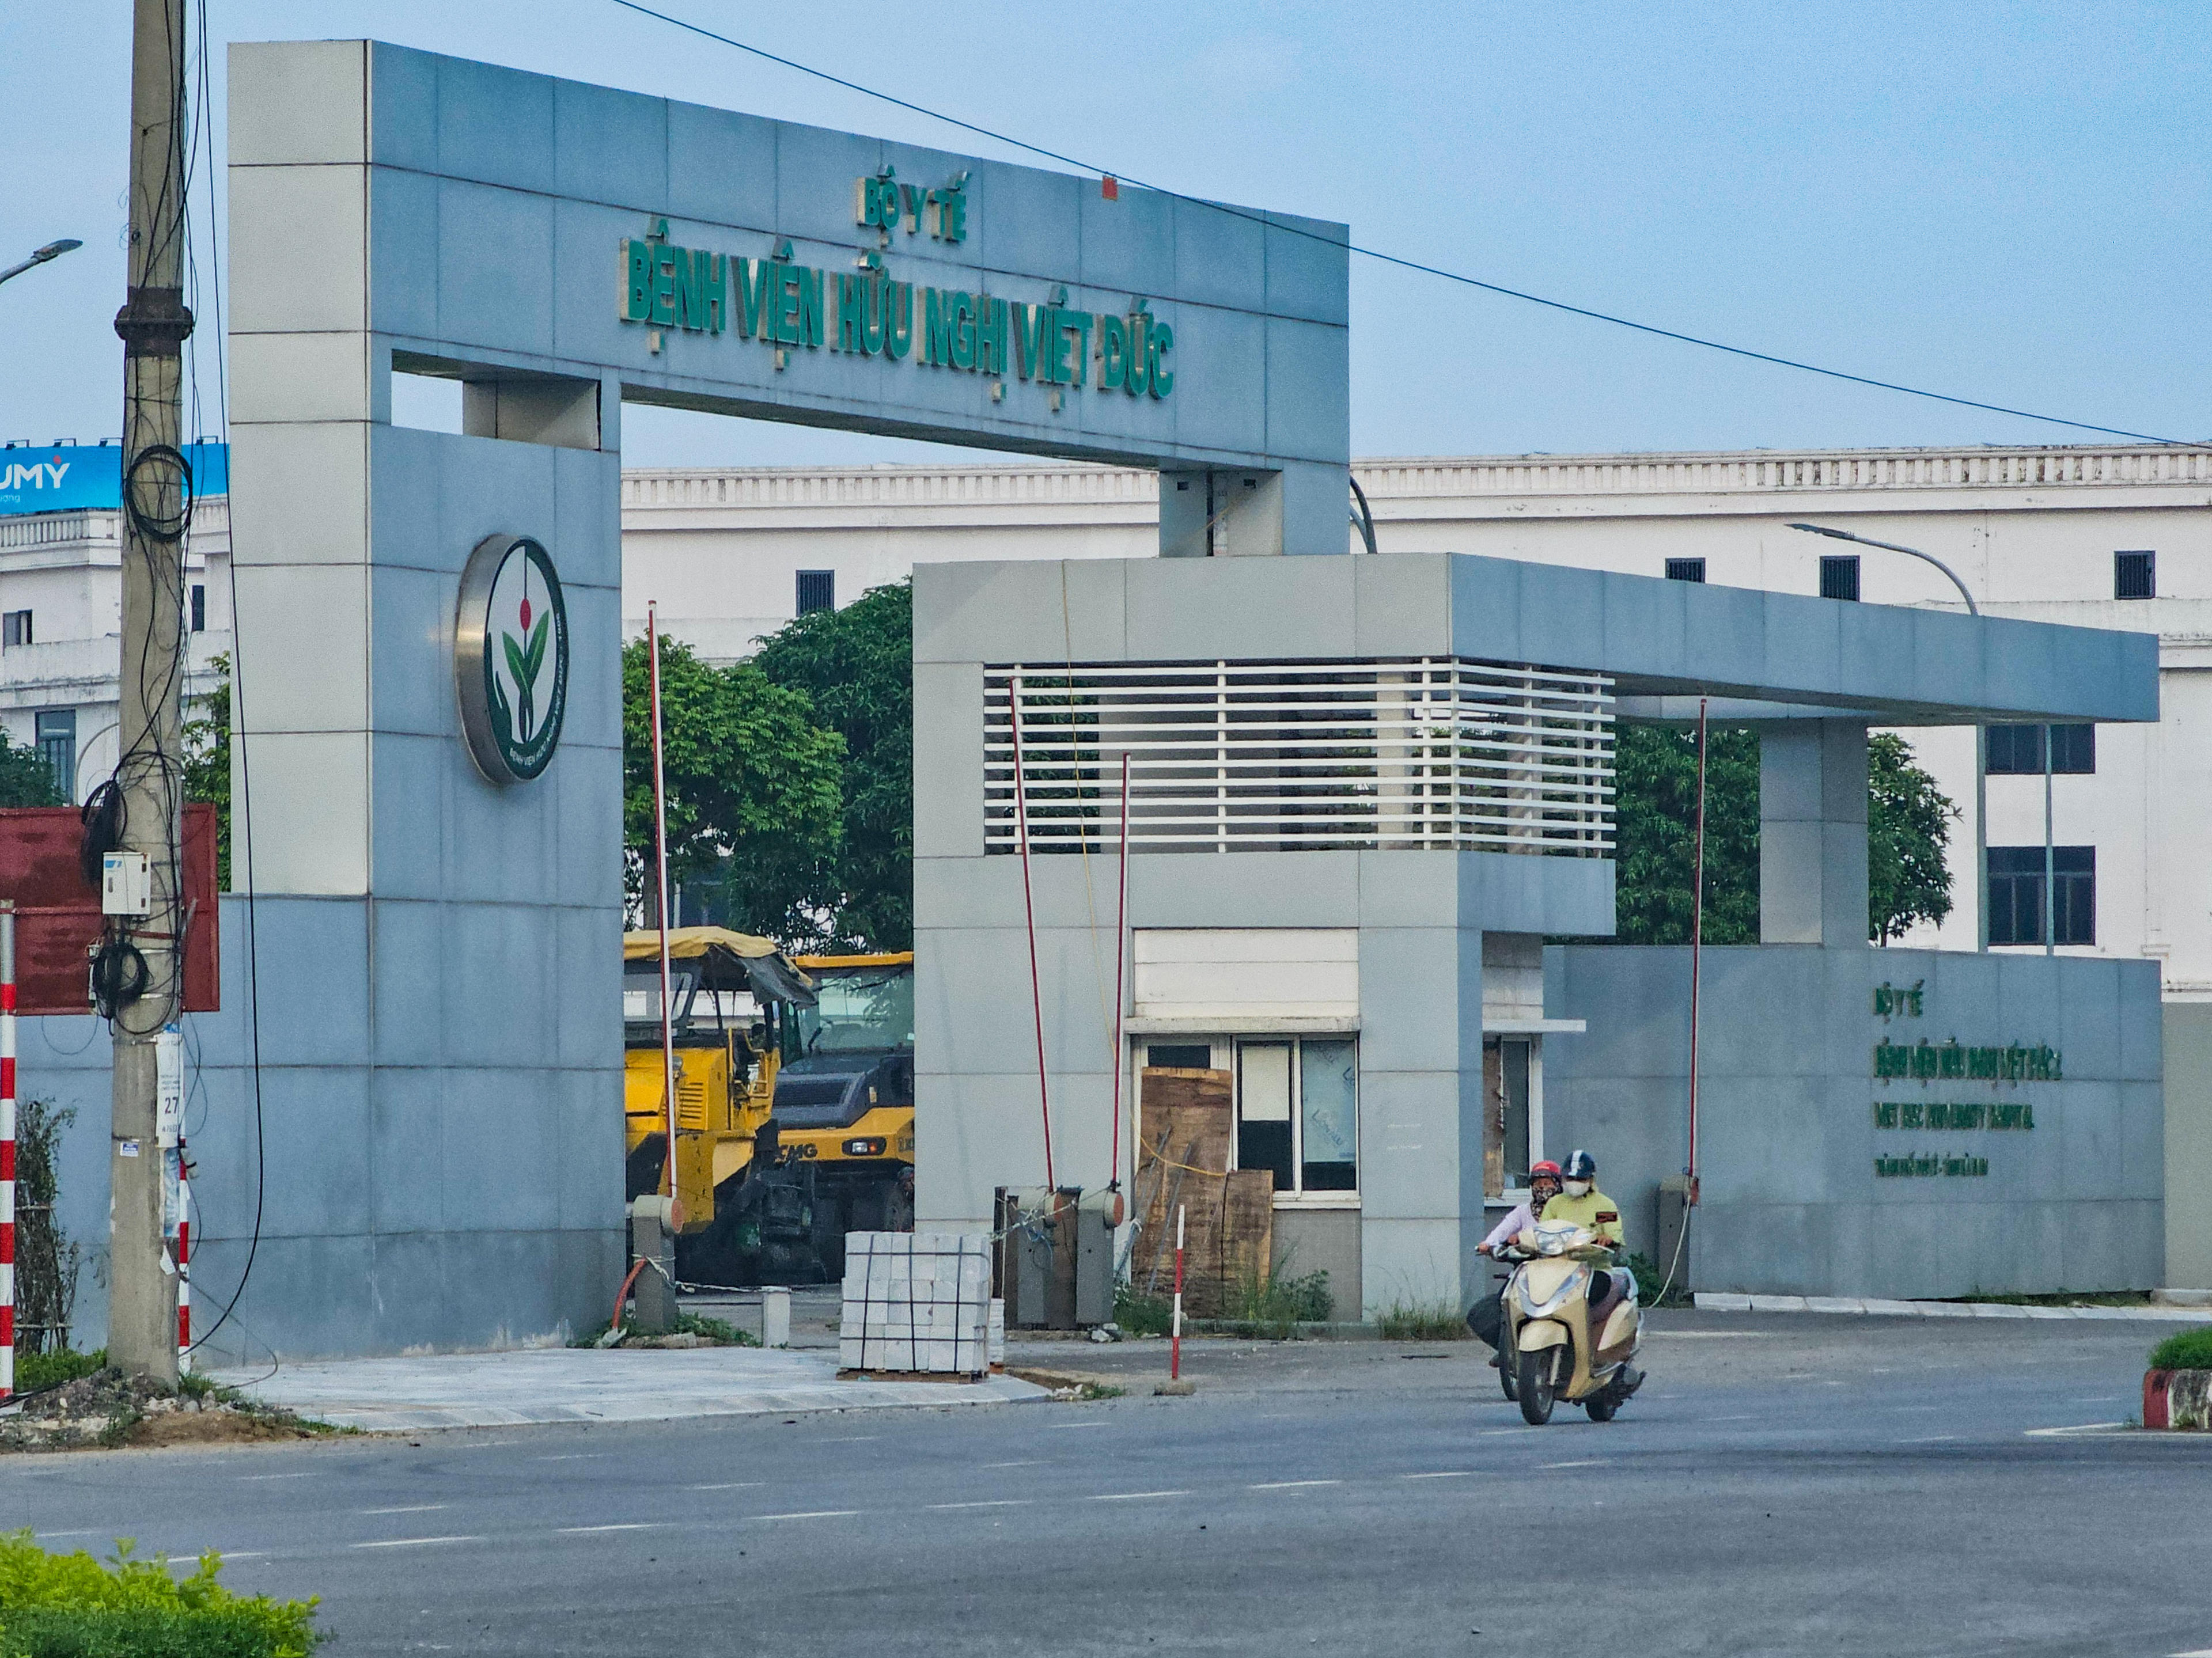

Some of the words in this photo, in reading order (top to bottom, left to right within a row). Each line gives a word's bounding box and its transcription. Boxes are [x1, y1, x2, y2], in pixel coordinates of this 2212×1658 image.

[857, 164, 899, 246] BỘ
[900, 184, 927, 234] Y
[927, 171, 971, 242] TẾ
[620, 215, 726, 354] BỆNH
[730, 236, 824, 370] VIỆN
[830, 249, 912, 359] HỮU
[916, 286, 1007, 401] NGHỊ
[1011, 284, 1094, 411] VIỆT
[1094, 295, 1173, 399] ĐỨC
[165, 1096, 178, 1114] 27
